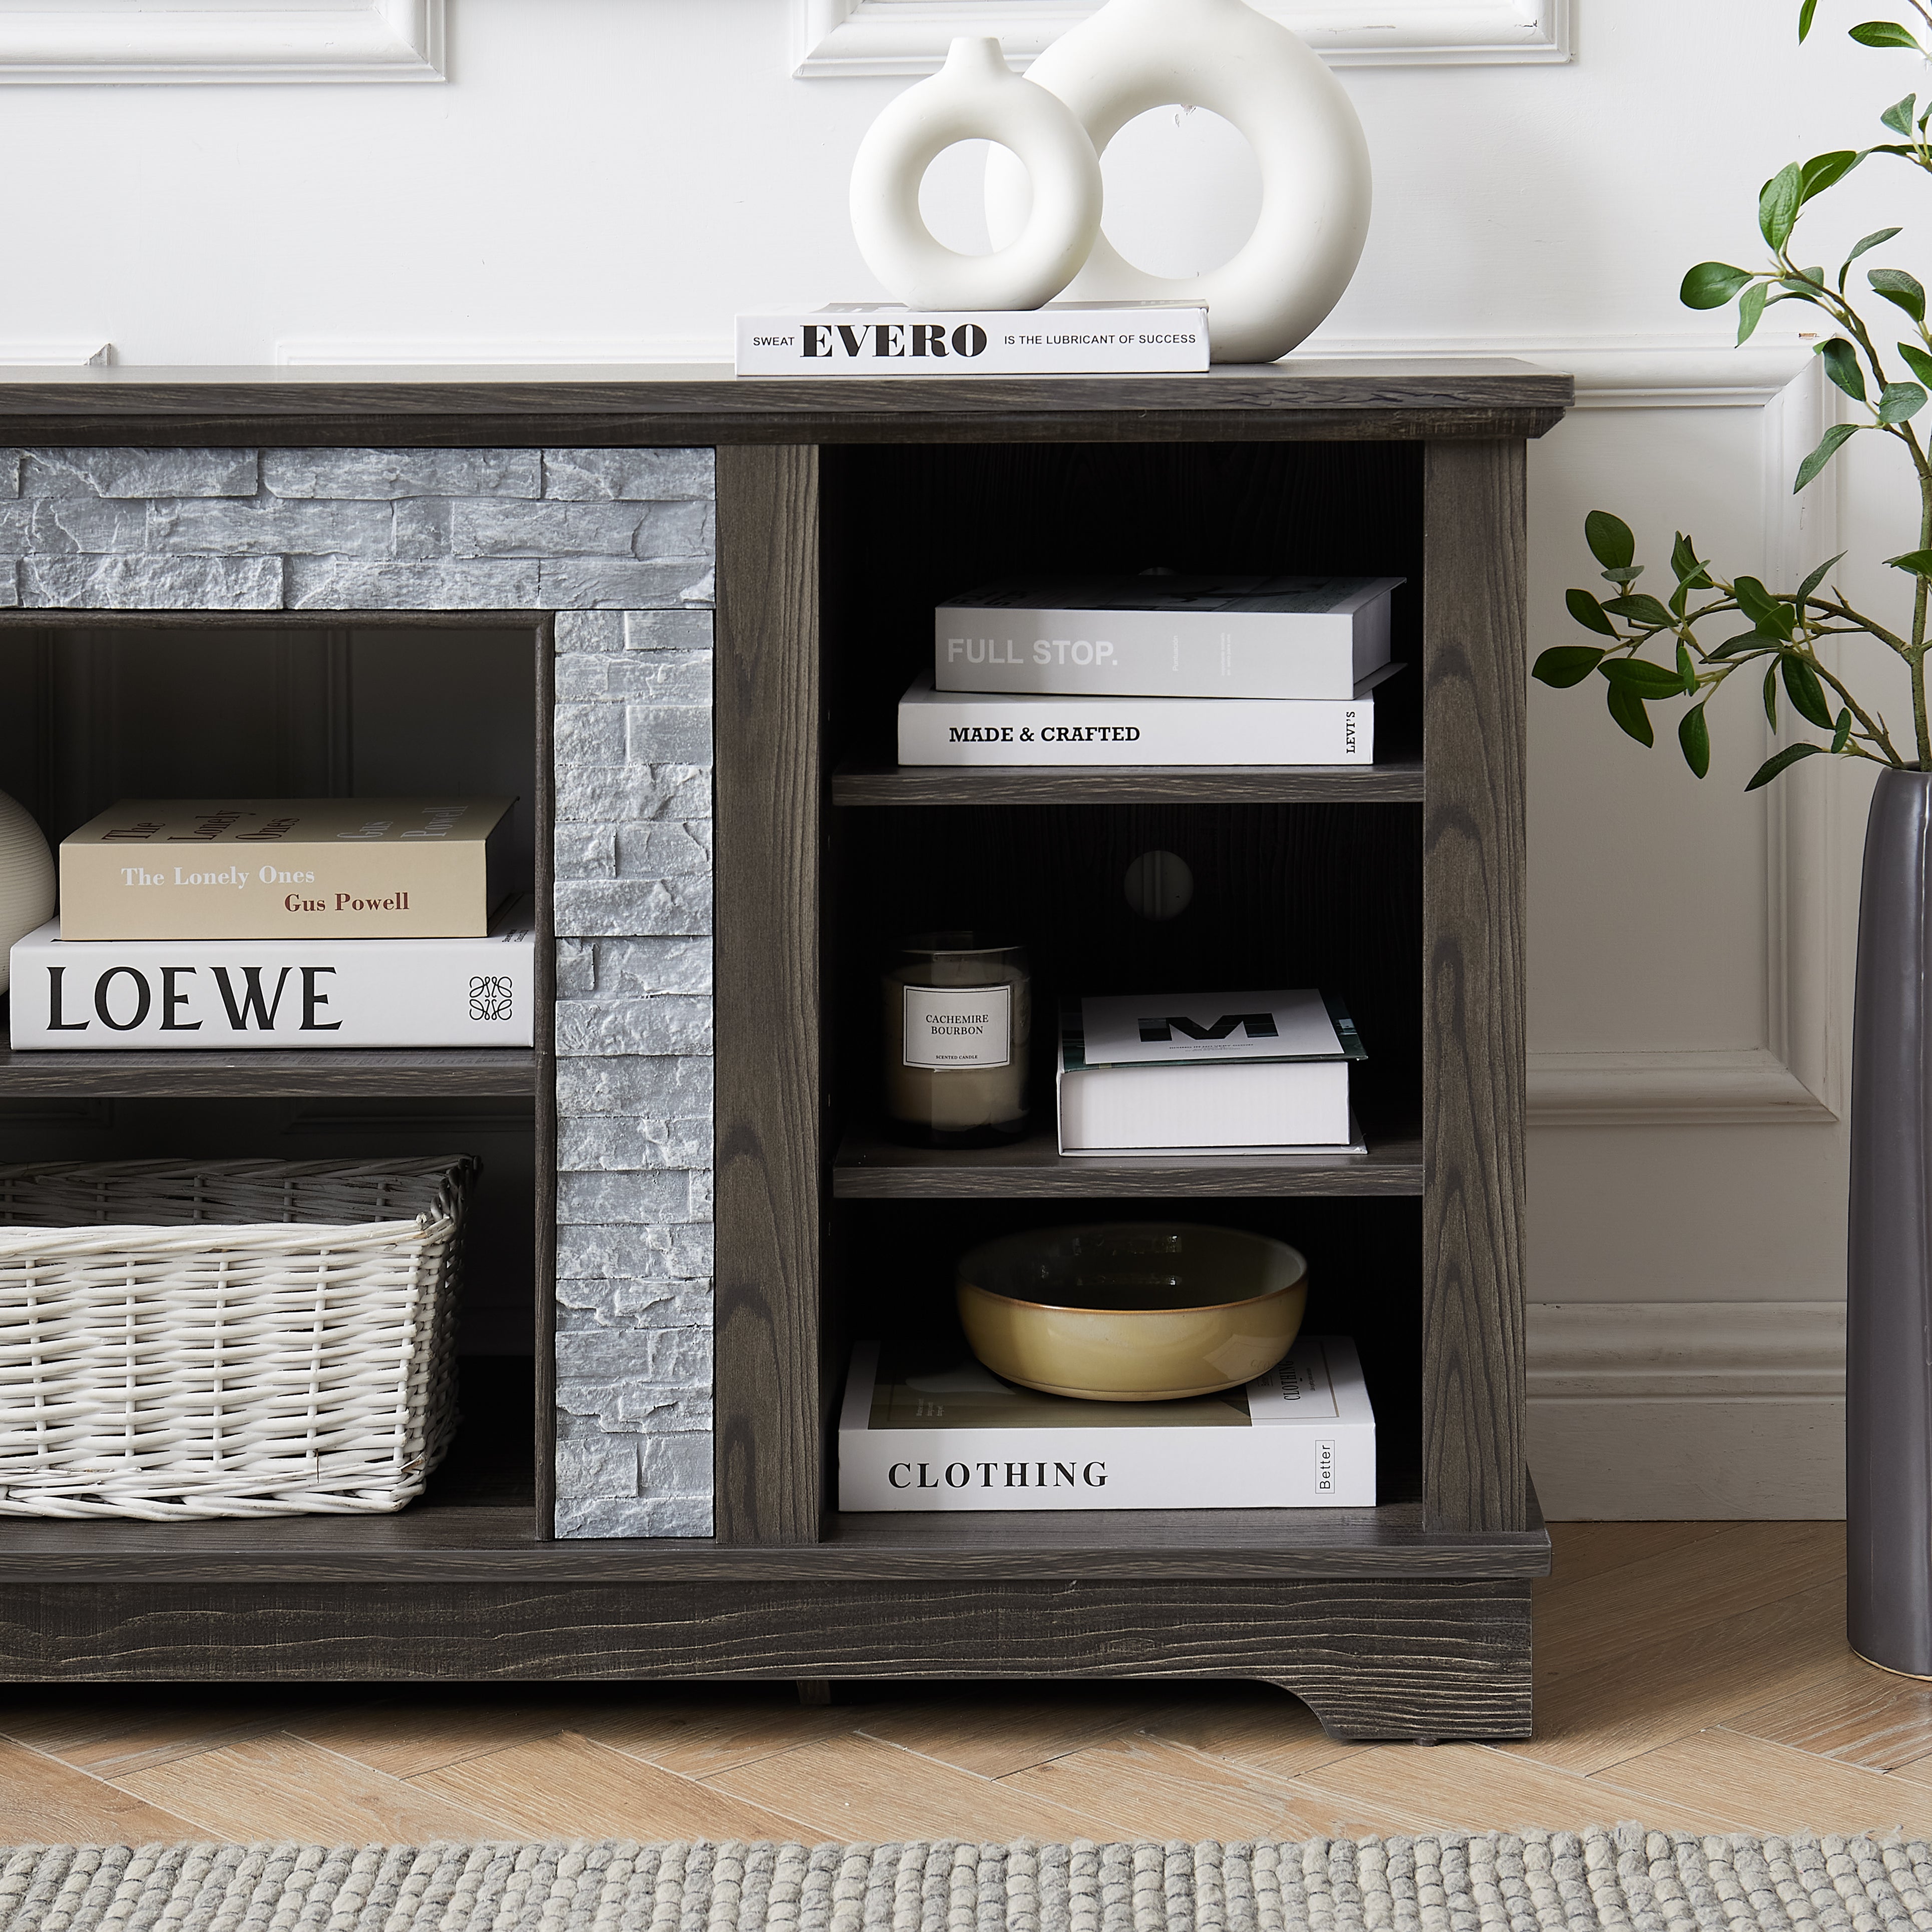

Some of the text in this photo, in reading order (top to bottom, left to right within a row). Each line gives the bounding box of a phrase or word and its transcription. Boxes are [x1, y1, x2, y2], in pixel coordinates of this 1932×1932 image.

[752, 323, 1196, 357] SWEAT EVERO IS THE LUBRICANT OF SUCCESS
[947, 638, 1118, 666] FULL STOP.
[949, 726, 1140, 742] MADE & CRAFTED
[101, 823, 166, 840] The
[167, 810, 256, 841] Lonely
[235, 808, 300, 840] Ones
[337, 821, 394, 839] Gus
[401, 806, 468, 838] Powell
[121, 865, 315, 889] The Lonely Ones
[284, 892, 410, 912] Gus Powell
[46, 966, 343, 1031] LOEWE
[926, 1014, 989, 1024] CACHEMIRE
[931, 1025, 983, 1035] BOURBON
[1137, 1012, 1279, 1042] M
[1278, 1361, 1301, 1400] CLOTHING
[888, 1461, 1108, 1489] CLOTHING
[1319, 1445, 1331, 1489] Better
